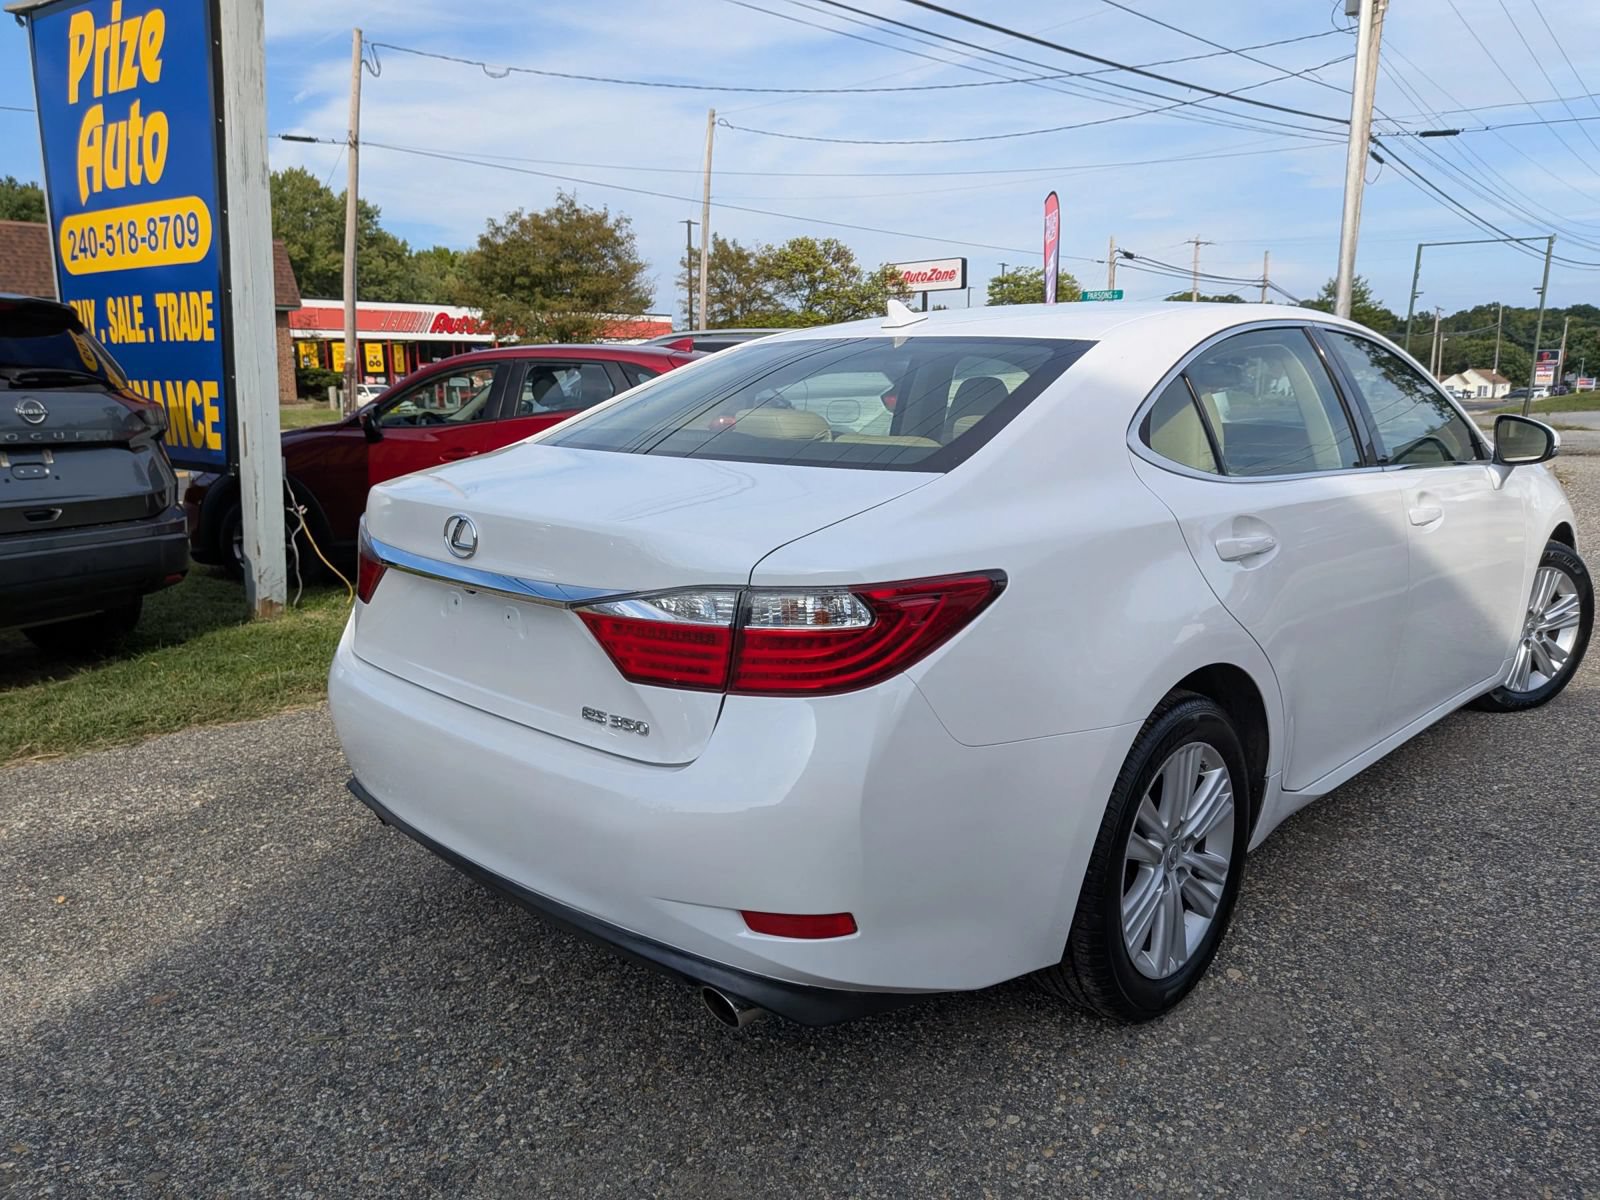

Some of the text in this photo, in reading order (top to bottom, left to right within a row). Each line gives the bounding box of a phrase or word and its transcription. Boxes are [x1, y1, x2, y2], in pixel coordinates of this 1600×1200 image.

[68, 0, 165, 105] Prize
[77, 98, 169, 207] Auto
[68, 211, 199, 261] 240-518-8709
[904, 267, 956, 283] AutoZone
[155, 291, 215, 342] TRADE
[127, 379, 222, 450] ANCE
[582, 706, 649, 737] ES 350
